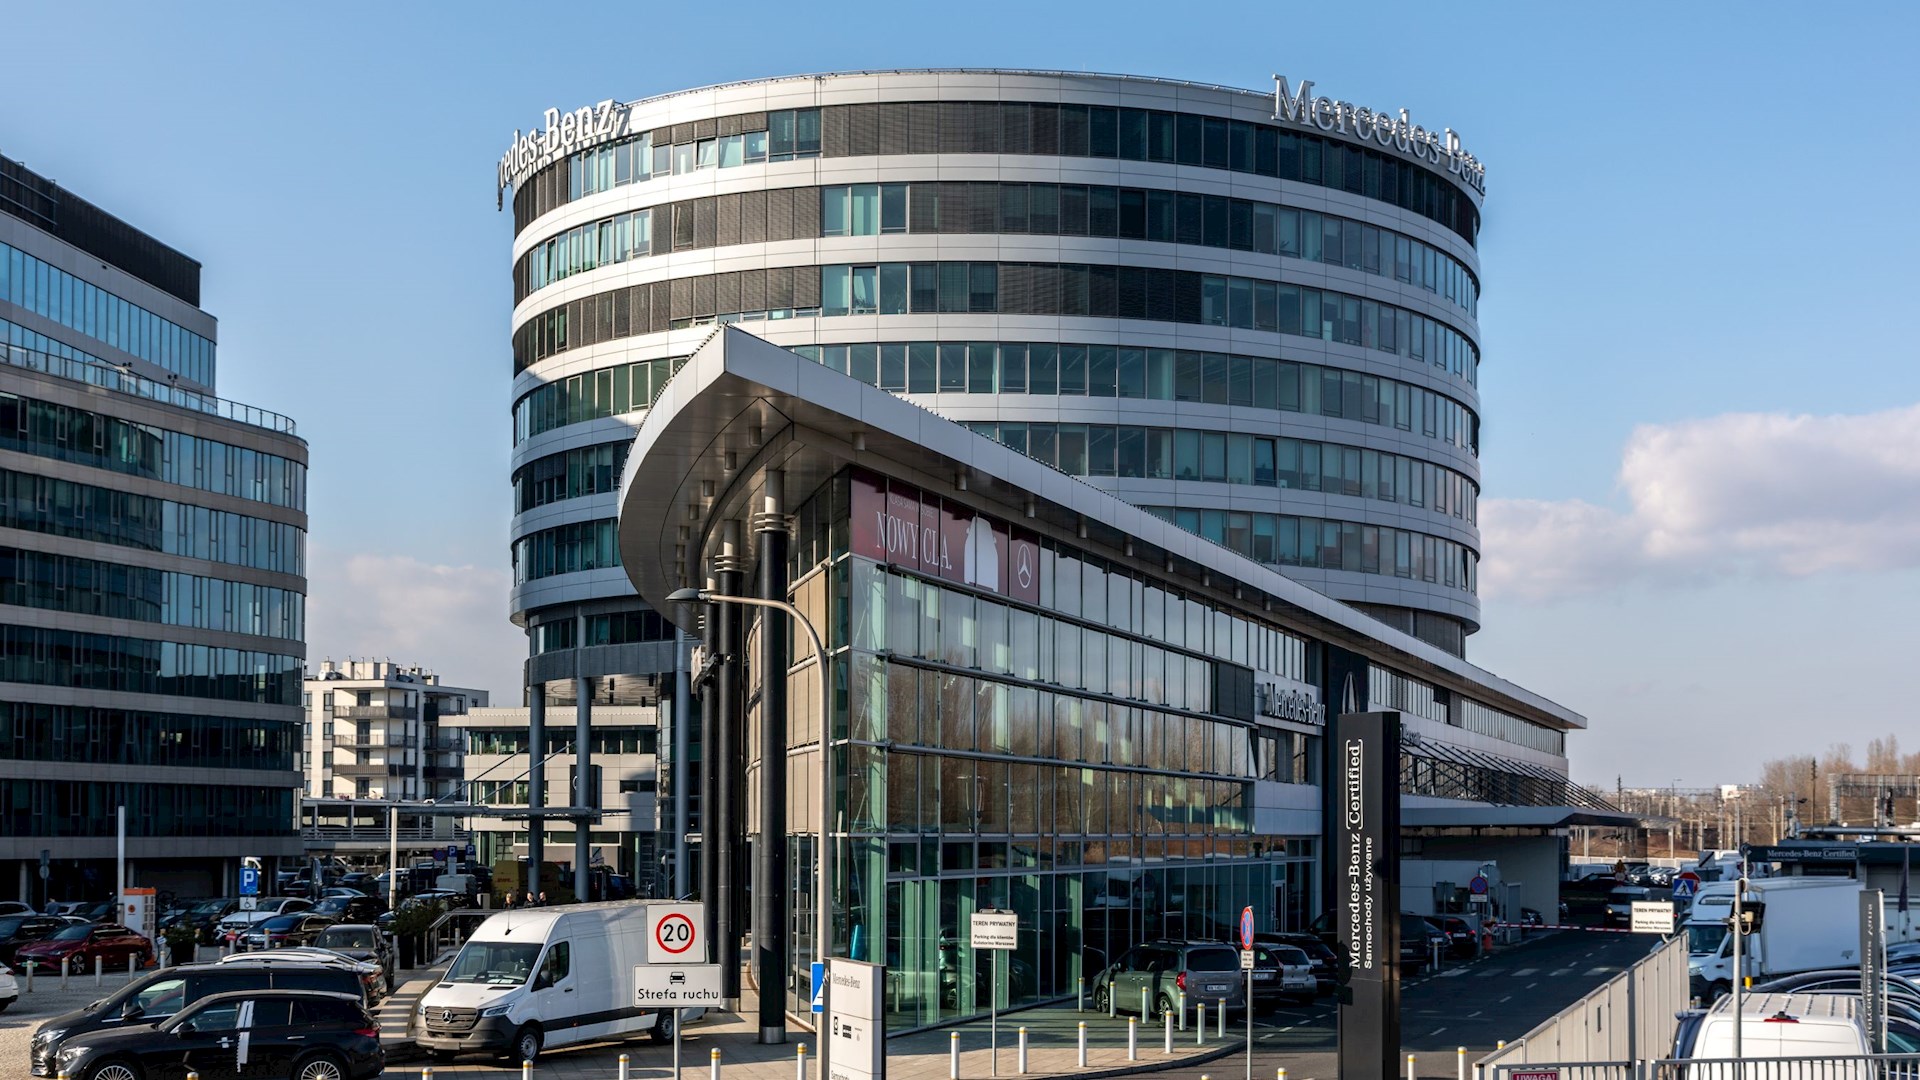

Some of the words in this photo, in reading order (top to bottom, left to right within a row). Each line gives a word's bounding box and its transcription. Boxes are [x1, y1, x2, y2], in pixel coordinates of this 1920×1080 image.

[876, 512, 919, 560] NOWY
[1349, 745, 1361, 824] Certified
[1364, 836, 1374, 892] używane
[1767, 849, 1822, 857] Mercedes-Benz
[243, 870, 255, 887] P
[1348, 833, 1361, 969] Mercedes-Benz
[663, 923, 690, 942] 20
[1364, 894, 1374, 969] Samochody
[637, 988, 677, 1000] Strefa
[683, 988, 719, 1000] ruchu
[832, 973, 860, 989] Mercedes-Benz
